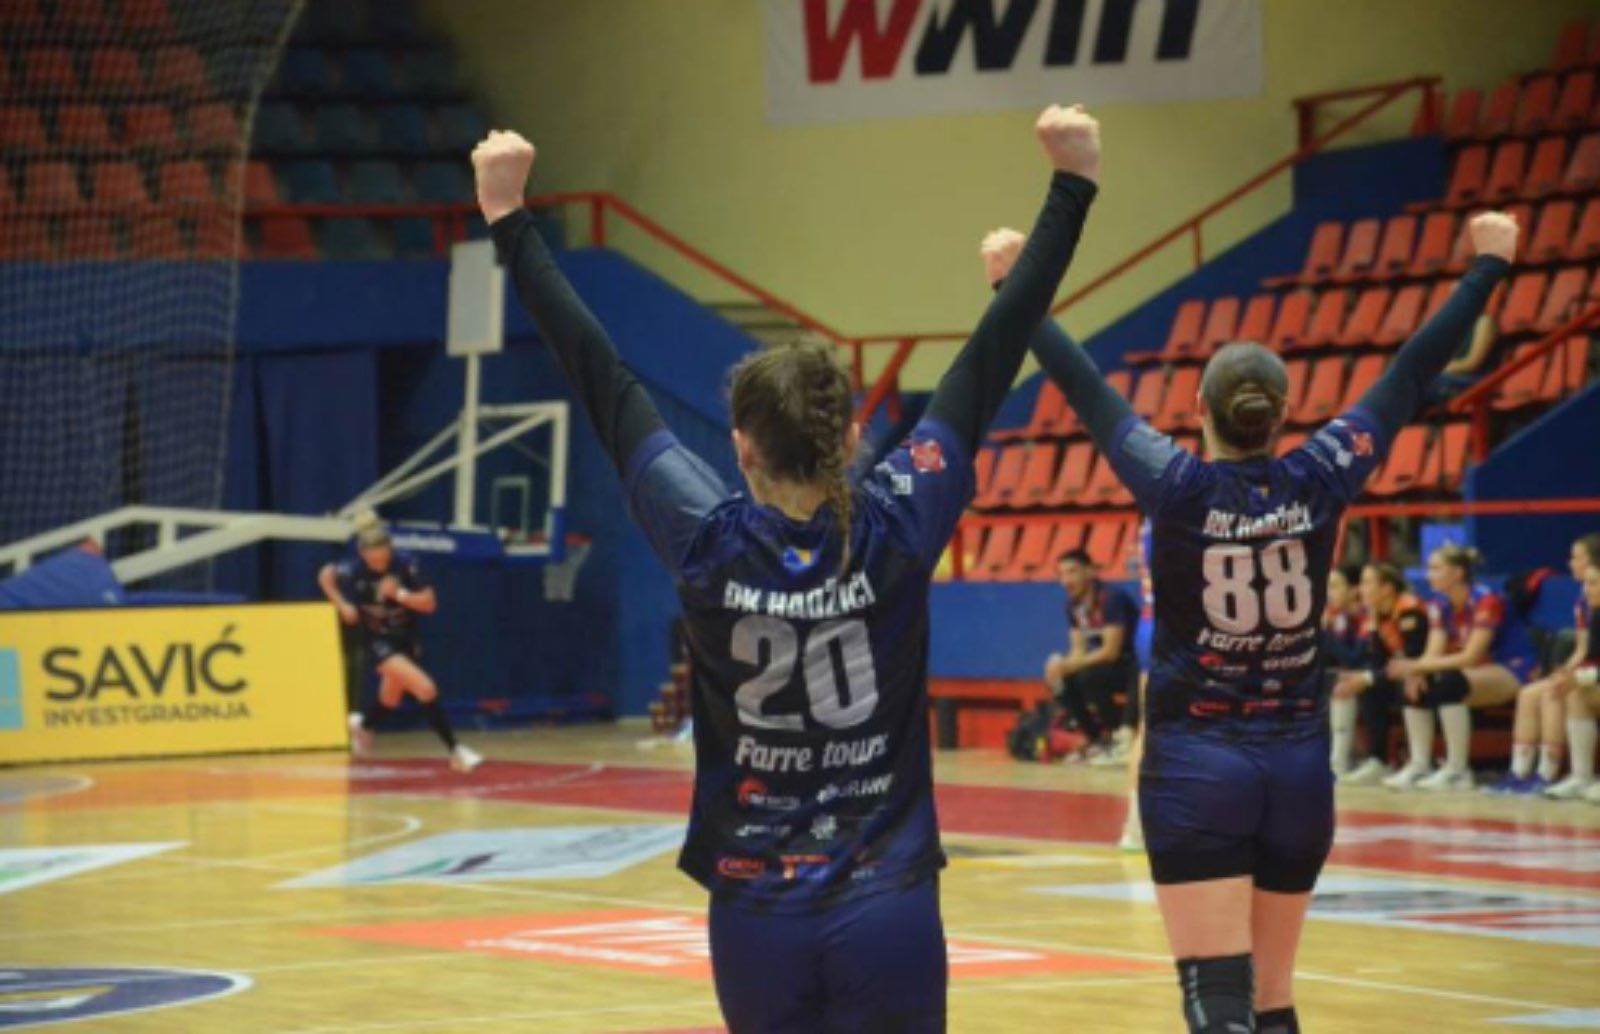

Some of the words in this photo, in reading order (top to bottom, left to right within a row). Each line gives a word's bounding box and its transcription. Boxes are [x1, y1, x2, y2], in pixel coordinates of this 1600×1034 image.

[1202, 540, 1312, 635] 88
[41, 625, 247, 700] SAVIĆ
[730, 615, 879, 731] 20
[44, 701, 250, 728] INVESTGRADNJA
[734, 734, 814, 772] Farre
